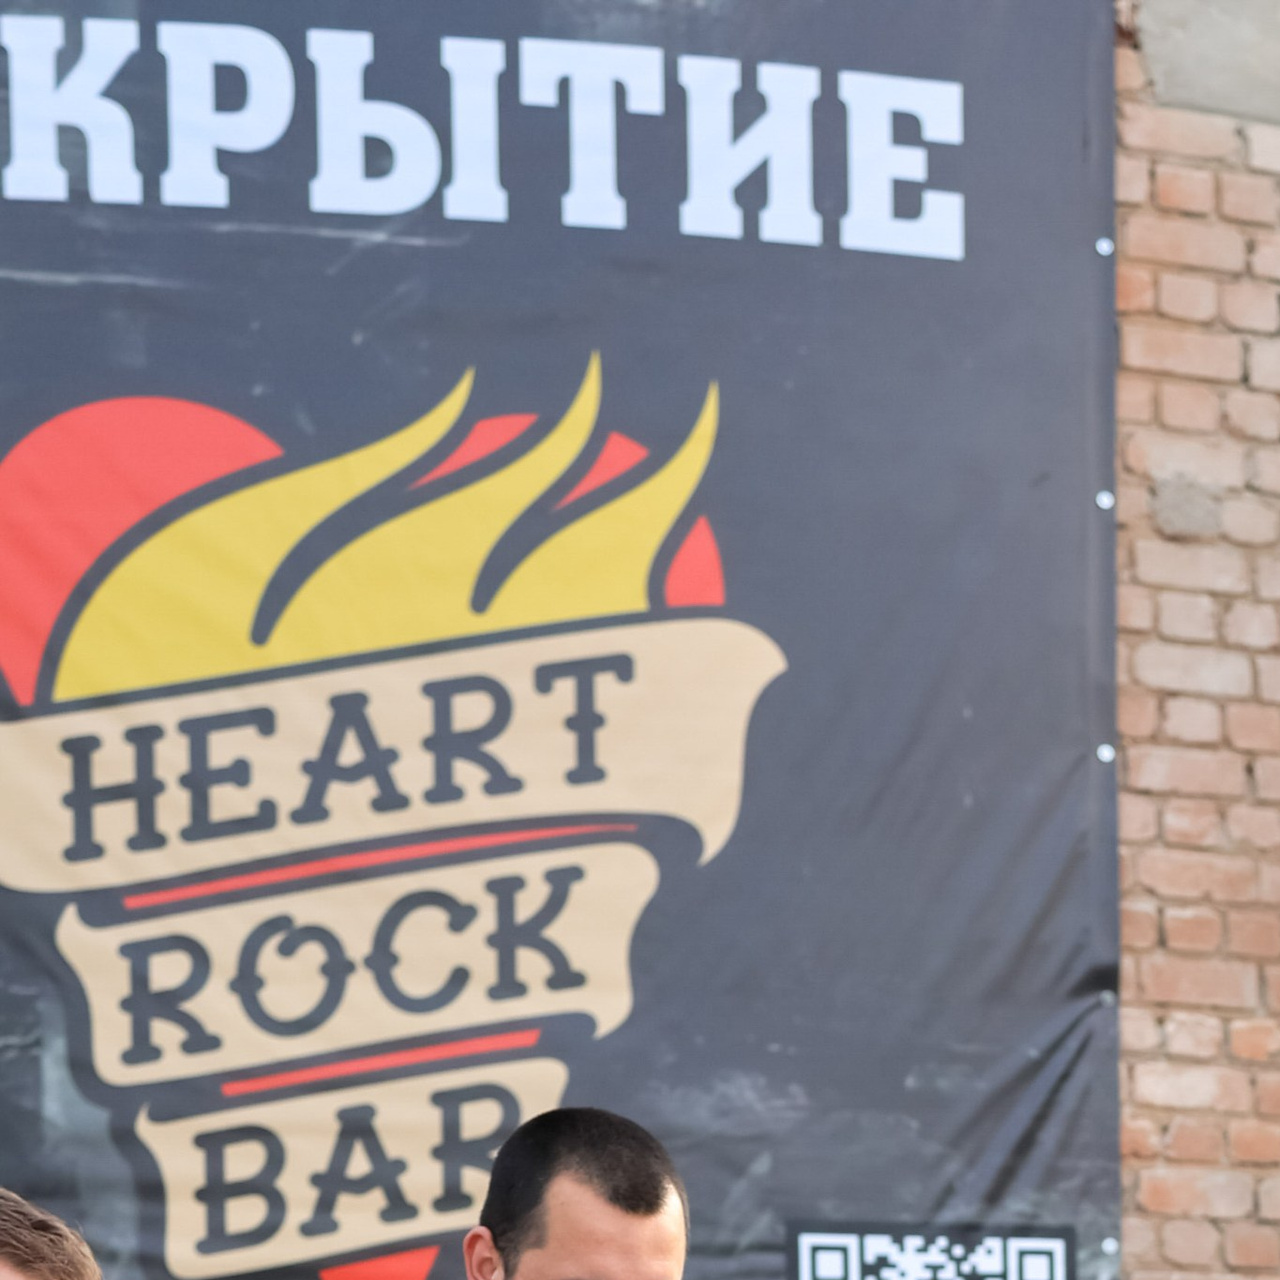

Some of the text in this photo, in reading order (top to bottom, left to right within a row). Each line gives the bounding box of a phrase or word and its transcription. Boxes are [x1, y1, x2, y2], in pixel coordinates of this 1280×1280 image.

[0, 14, 966, 262] КРЫТИЕ
[61, 653, 635, 863] HEART
[120, 865, 587, 1065] ROCK
[195, 1082, 521, 1255] BAR
